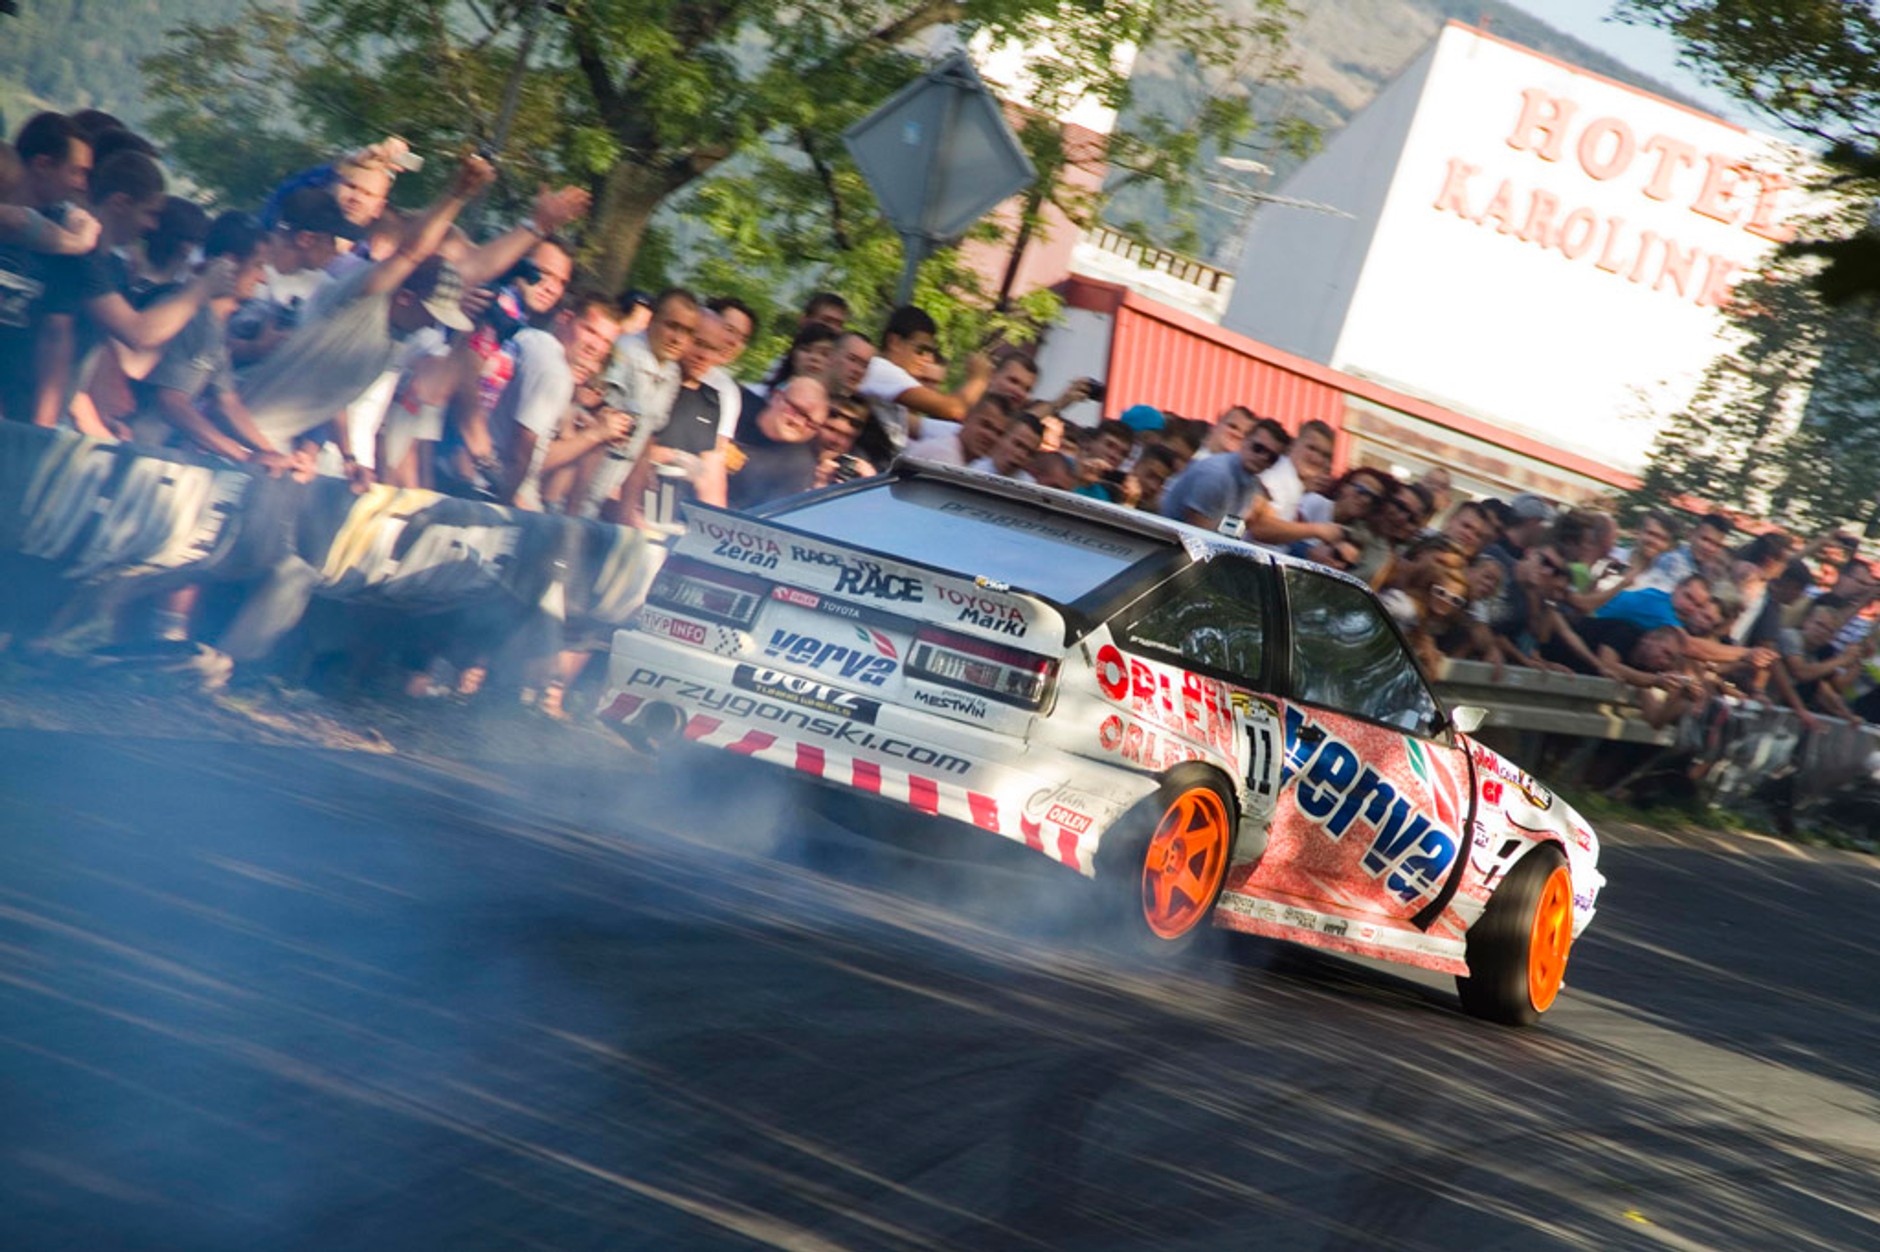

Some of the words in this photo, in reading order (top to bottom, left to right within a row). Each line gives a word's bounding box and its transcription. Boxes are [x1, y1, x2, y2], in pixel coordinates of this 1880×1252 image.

[1506, 87, 1797, 243] HOTEL
[1433, 157, 1762, 314] KAROLINK
[696, 517, 782, 555] TOYOTA
[834, 566, 924, 603] RACE
[935, 584, 1025, 622] TOYOTA
[823, 601, 860, 618] TOYOTA
[957, 607, 1029, 639] Marki
[672, 620, 705, 642] INFO
[764, 629, 898, 687] verva
[914, 690, 986, 719] MESTWIN
[1096, 644, 1240, 774] ORLEN
[1245, 723, 1272, 796] 11
[1049, 806, 1090, 832] ORLEN
[1281, 704, 1457, 904] verva
